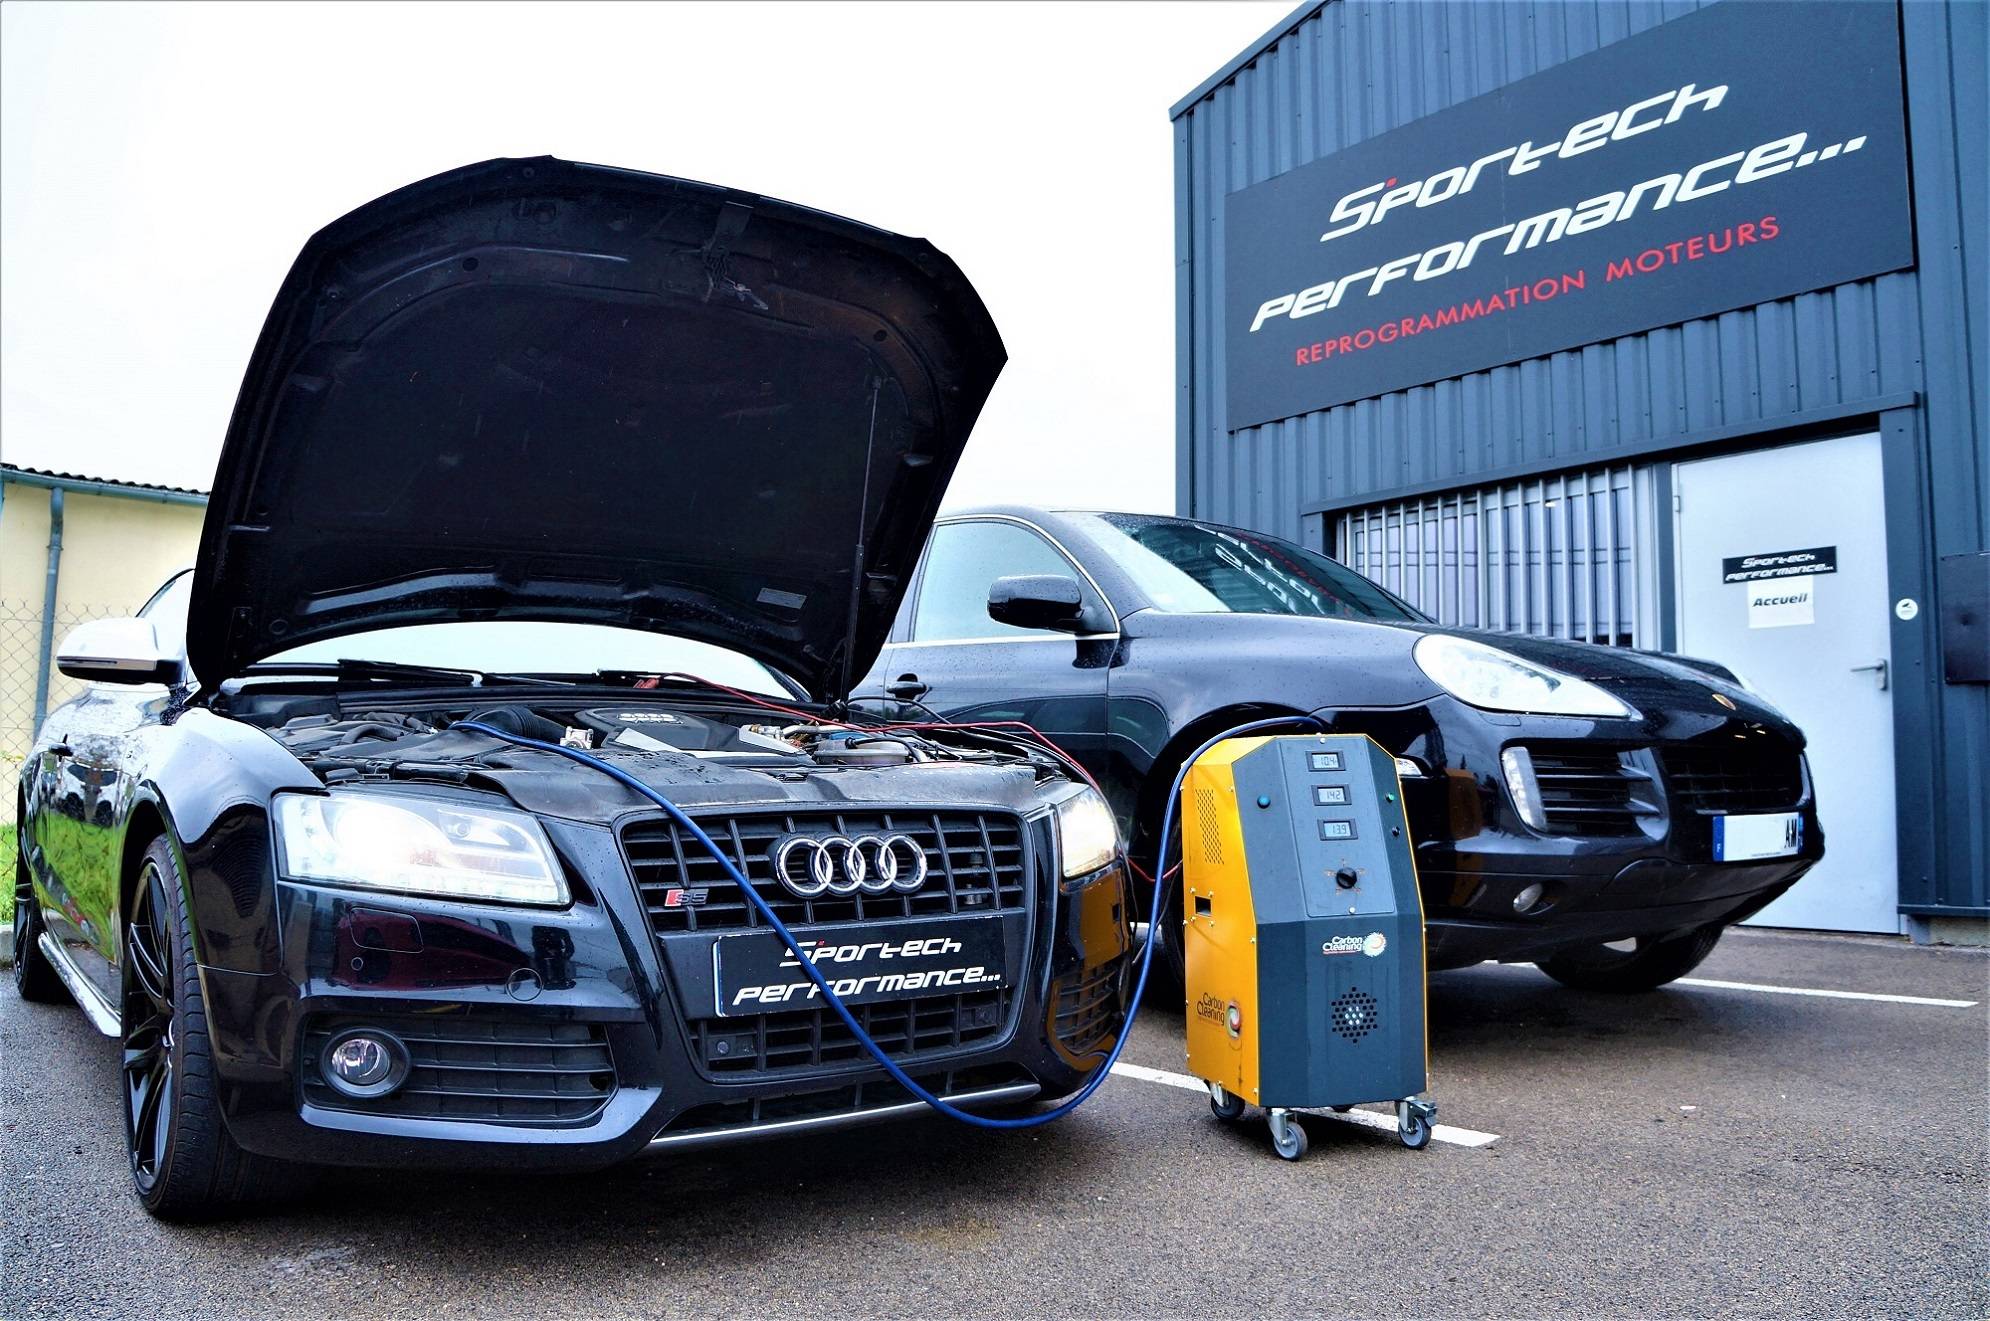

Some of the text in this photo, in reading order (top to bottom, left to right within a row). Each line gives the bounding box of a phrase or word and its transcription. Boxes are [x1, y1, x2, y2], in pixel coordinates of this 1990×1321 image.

[1319, 83, 1729, 242] Sportech
[1296, 215, 1780, 366] REPROGRAMMATION MOTEURS
[1752, 593, 1808, 607] Accueil
[1322, 942, 1363, 952] Cleaning
[1331, 935, 1364, 945] Carbon
[1203, 992, 1225, 1012] Carbon
[1197, 1000, 1225, 1026] Cleaning
